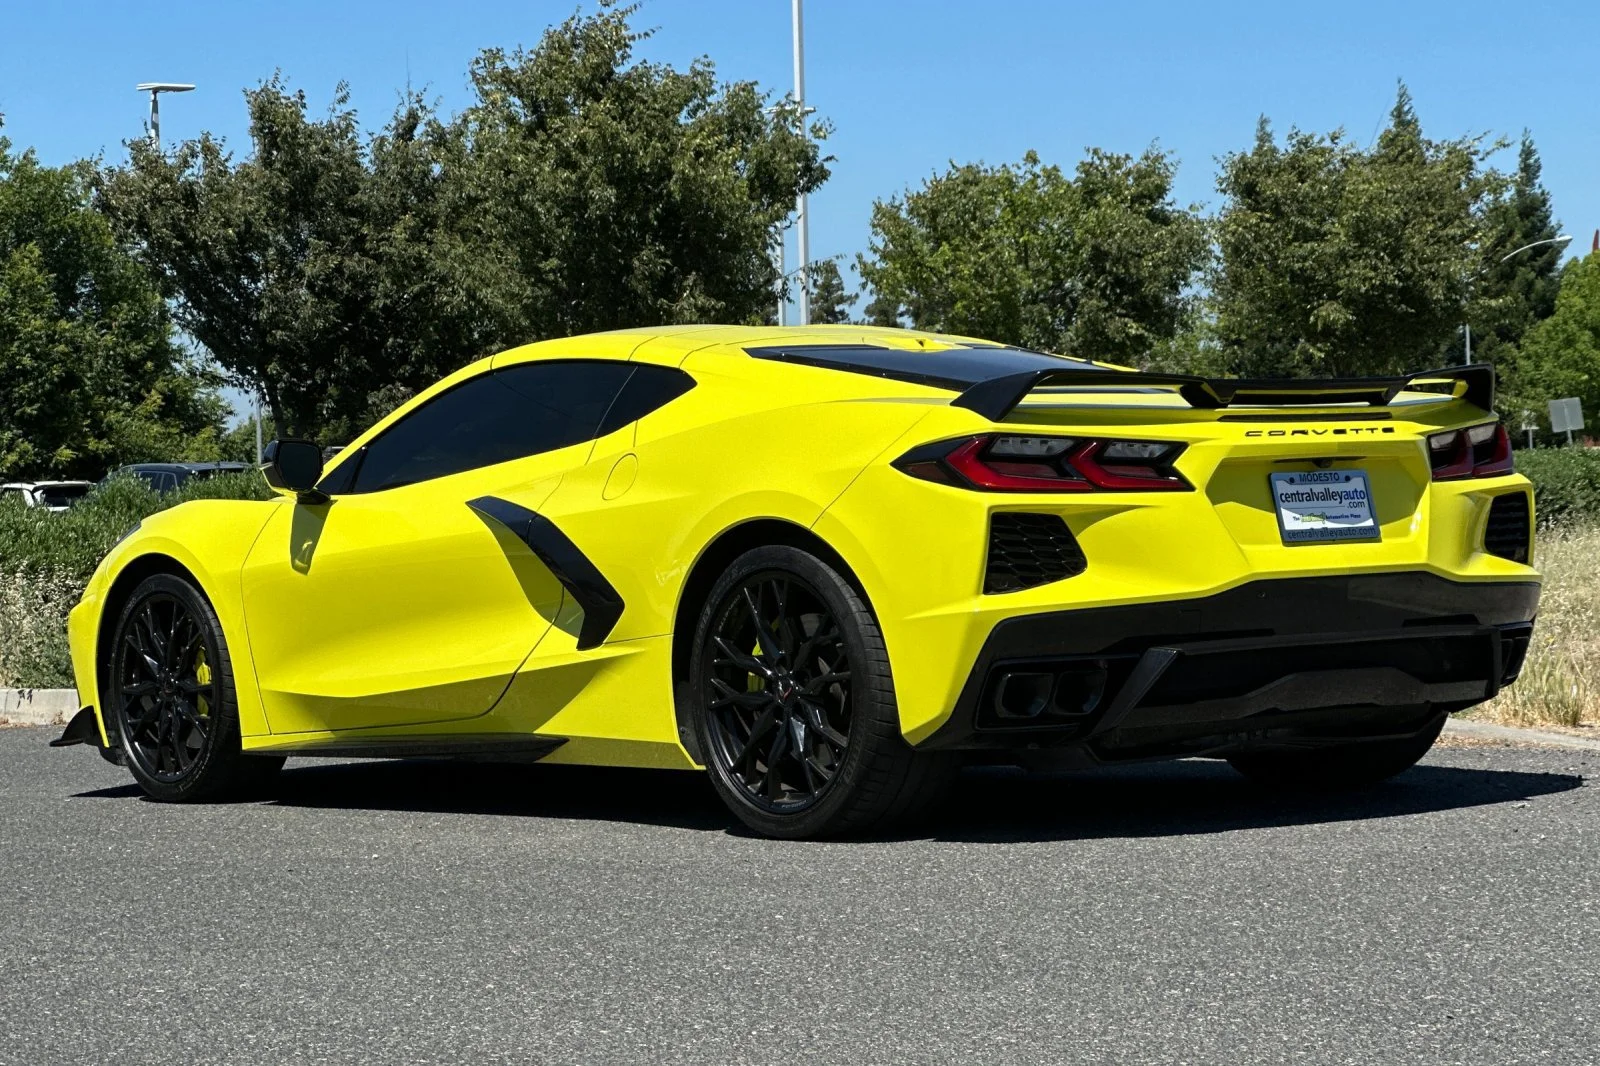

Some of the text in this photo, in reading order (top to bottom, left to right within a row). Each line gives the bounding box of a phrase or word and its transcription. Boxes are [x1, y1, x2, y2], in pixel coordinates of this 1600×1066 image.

[1245, 427, 1395, 437] CORVETTE
[1299, 472, 1340, 483] MODESTO
[1280, 488, 1366, 504] centralvalleyauto
[1347, 501, 1366, 509] .com
[1287, 527, 1376, 539] centralvalleyauto.com
